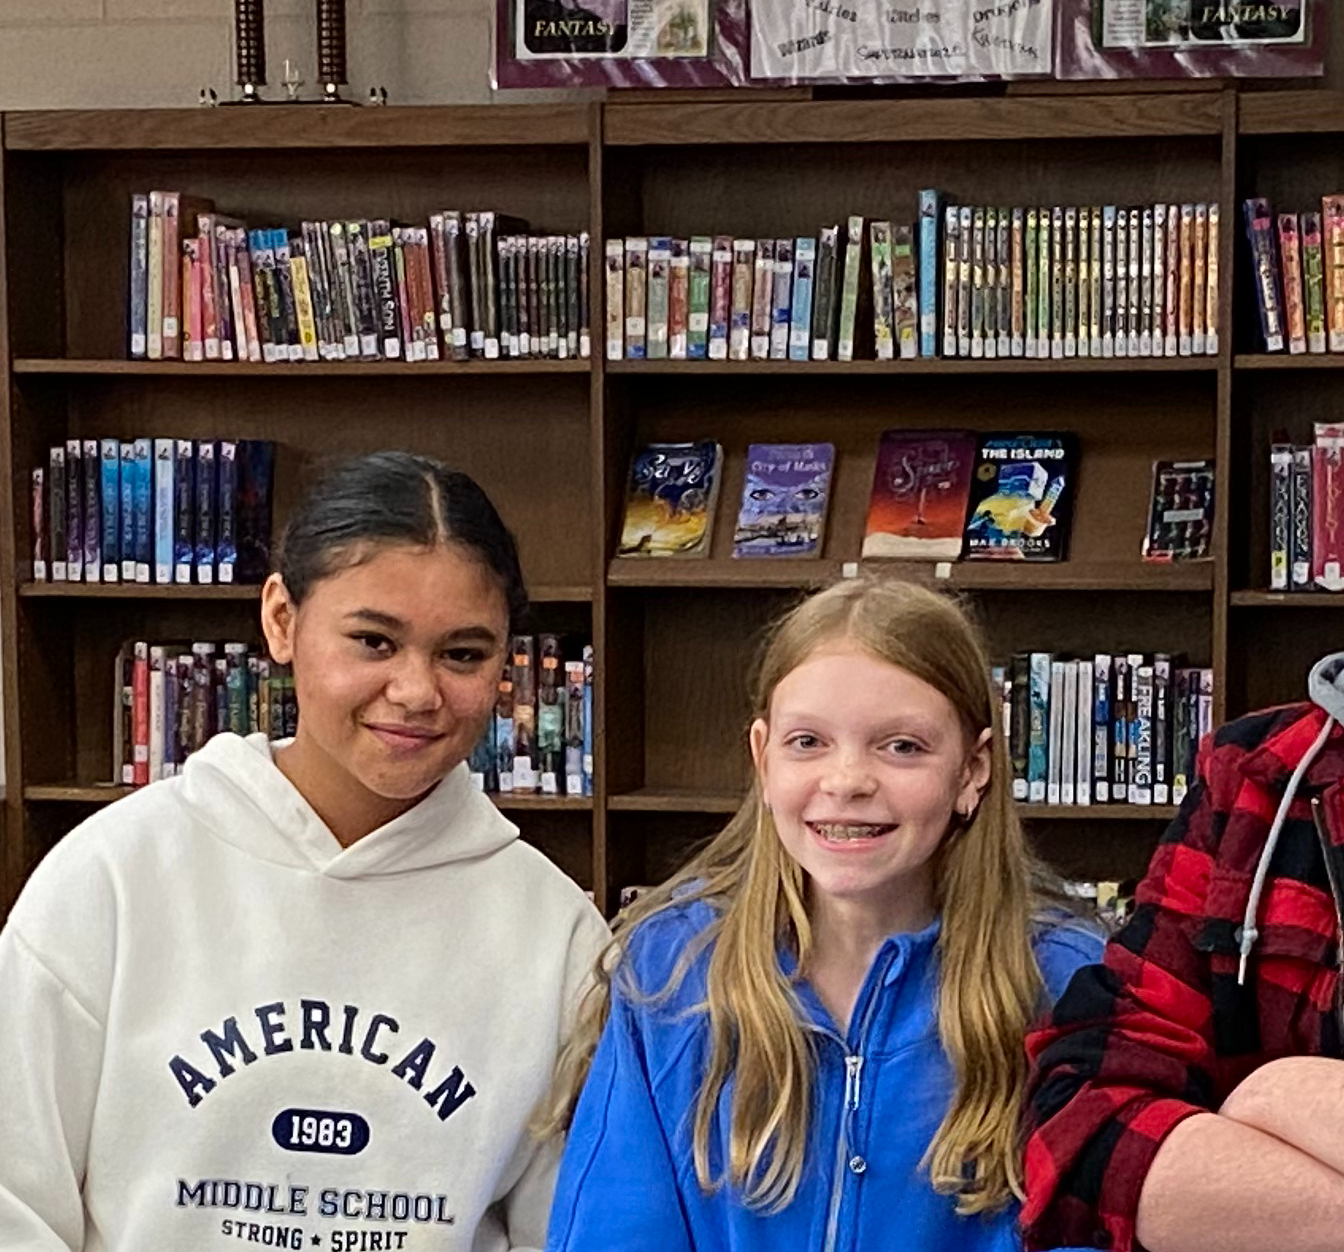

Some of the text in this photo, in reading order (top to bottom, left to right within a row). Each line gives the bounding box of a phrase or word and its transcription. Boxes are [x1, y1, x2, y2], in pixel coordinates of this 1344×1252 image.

[533, 19, 616, 38] FANTASY
[1201, 3, 1292, 24] FANTASY
[981, 448, 1065, 460] THE ISLAND
[167, 998, 477, 1122] AMERICAN
[289, 1114, 353, 1149] 1983
[176, 1179, 455, 1226] MIDDLE SCHOOL
[221, 1218, 302, 1250] STRONG
